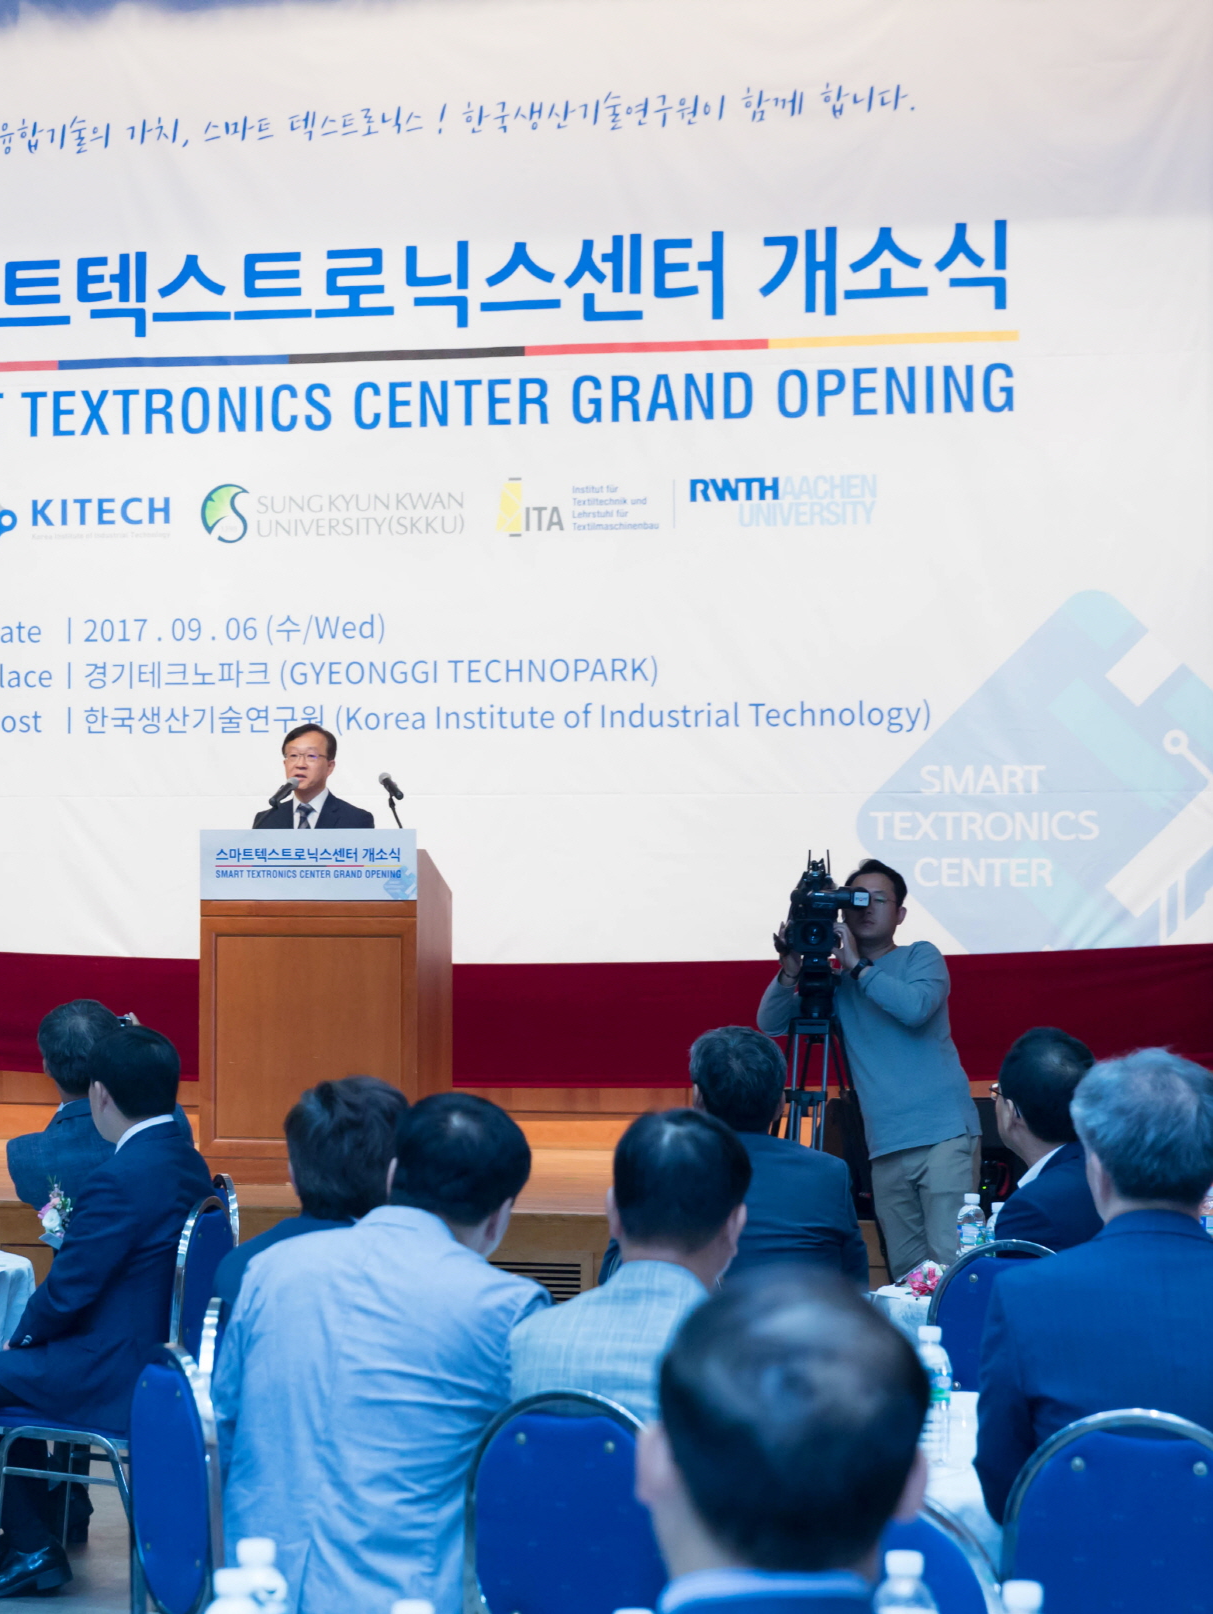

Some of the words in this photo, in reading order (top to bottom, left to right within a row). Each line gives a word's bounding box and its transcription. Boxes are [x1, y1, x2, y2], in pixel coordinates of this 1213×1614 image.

[0, 116, 110, 155] 융합기술의
[127, 117, 188, 147] 가치,
[205, 116, 273, 142] 스마트
[289, 106, 423, 141] 텍스트로닉스
[463, 92, 725, 133] 한국생산기술연구원이
[742, 87, 803, 122] 함께
[821, 83, 915, 119] 합니다.
[759, 219, 1007, 316] 개소식
[21, 383, 331, 437] TEXTRONICS
[354, 378, 549, 430] CENTER
[572, 372, 753, 424] GRAND
[778, 363, 1013, 418] OPENING
[572, 485, 603, 493] Institut
[606, 485, 619, 493] für
[572, 497, 627, 506] Textiltechnik
[631, 497, 647, 505] und
[690, 477, 779, 502] RWTH
[781, 474, 878, 500] AACHEN
[32, 497, 170, 526] KITECH
[525, 506, 564, 531] ITA
[572, 509, 613, 518] Lehrstuhl
[615, 508, 629, 517] für
[738, 502, 876, 527] UNIVERSITY
[257, 515, 464, 537] UNIVERSITY(SKKU)
[572, 521, 660, 531] Textilmaschinenbau
[85, 660, 270, 689] 경기테크노파크
[281, 660, 437, 690] (GYEONGGI
[448, 656, 657, 687] TECHNOPARK)
[336, 705, 425, 736] (Korea
[437, 704, 554, 729] Institute
[564, 703, 592, 728] of
[601, 702, 739, 728] Industrial
[749, 699, 930, 733] Technology)
[920, 765, 1045, 794] SMART
[870, 810, 1099, 841] TEXTRONICS
[216, 848, 357, 862] 스마트텍스트로닉스센터
[362, 848, 400, 862] 개소식
[216, 869, 244, 879] SMART
[246, 869, 297, 879] TEXTRONICS
[300, 869, 331, 879] CENTER
[334, 869, 362, 879] GRAND
[365, 869, 402, 879] OPENING
[914, 857, 1053, 887] CENTER
